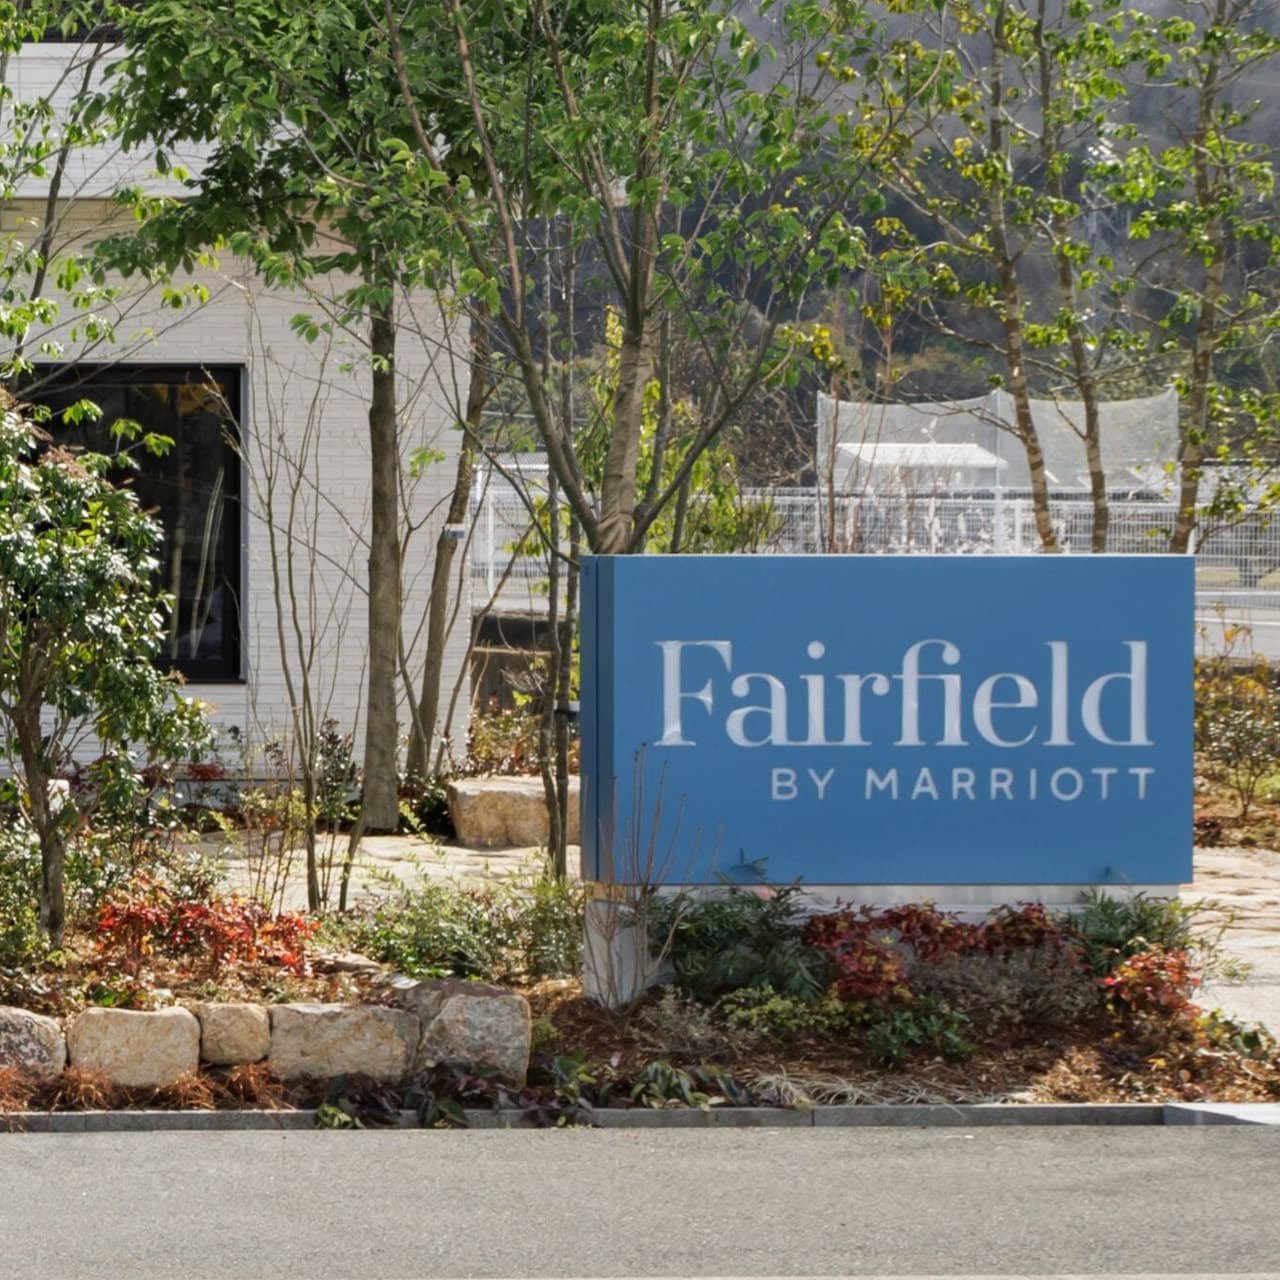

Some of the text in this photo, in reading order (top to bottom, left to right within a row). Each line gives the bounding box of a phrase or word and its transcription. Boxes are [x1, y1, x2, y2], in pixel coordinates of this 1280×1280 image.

[654, 638, 1156, 748] Fairfield
[772, 767, 1155, 801] BY MARRIOTT
